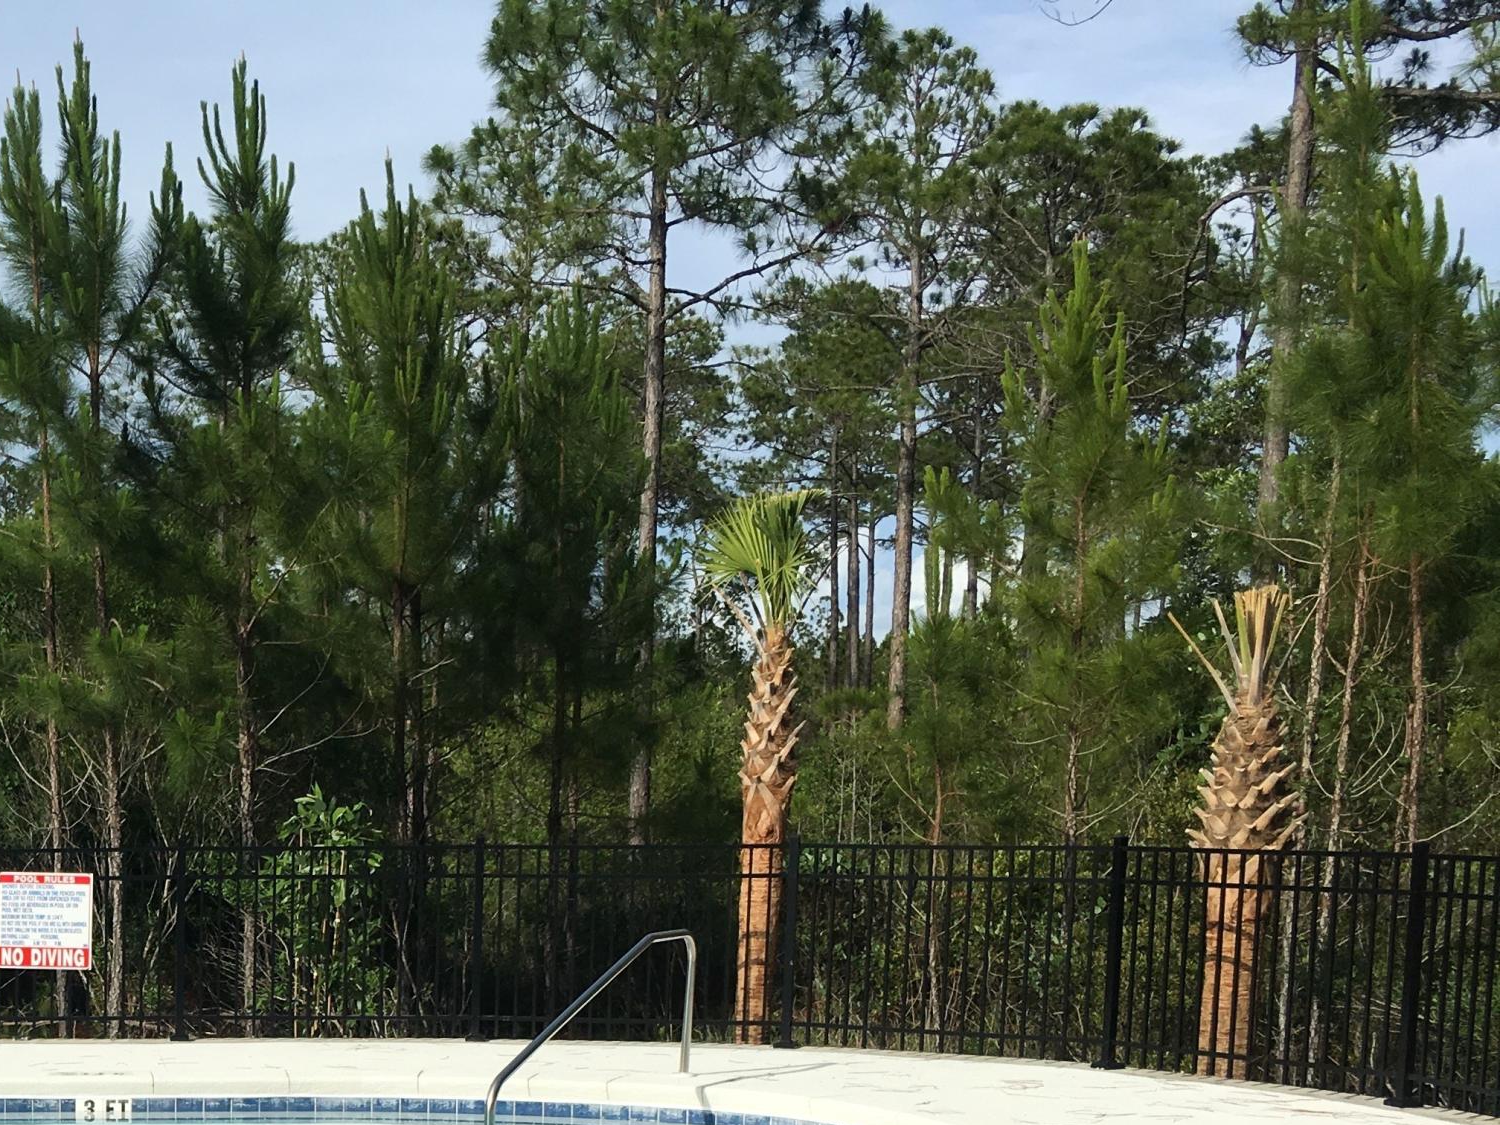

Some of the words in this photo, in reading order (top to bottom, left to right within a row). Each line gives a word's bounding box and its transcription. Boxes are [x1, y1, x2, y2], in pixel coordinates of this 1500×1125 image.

[13, 875, 39, 883] POOL
[44, 876, 76, 884] RULES
[1, 947, 24, 966] NO
[31, 948, 85, 967] DIVING
